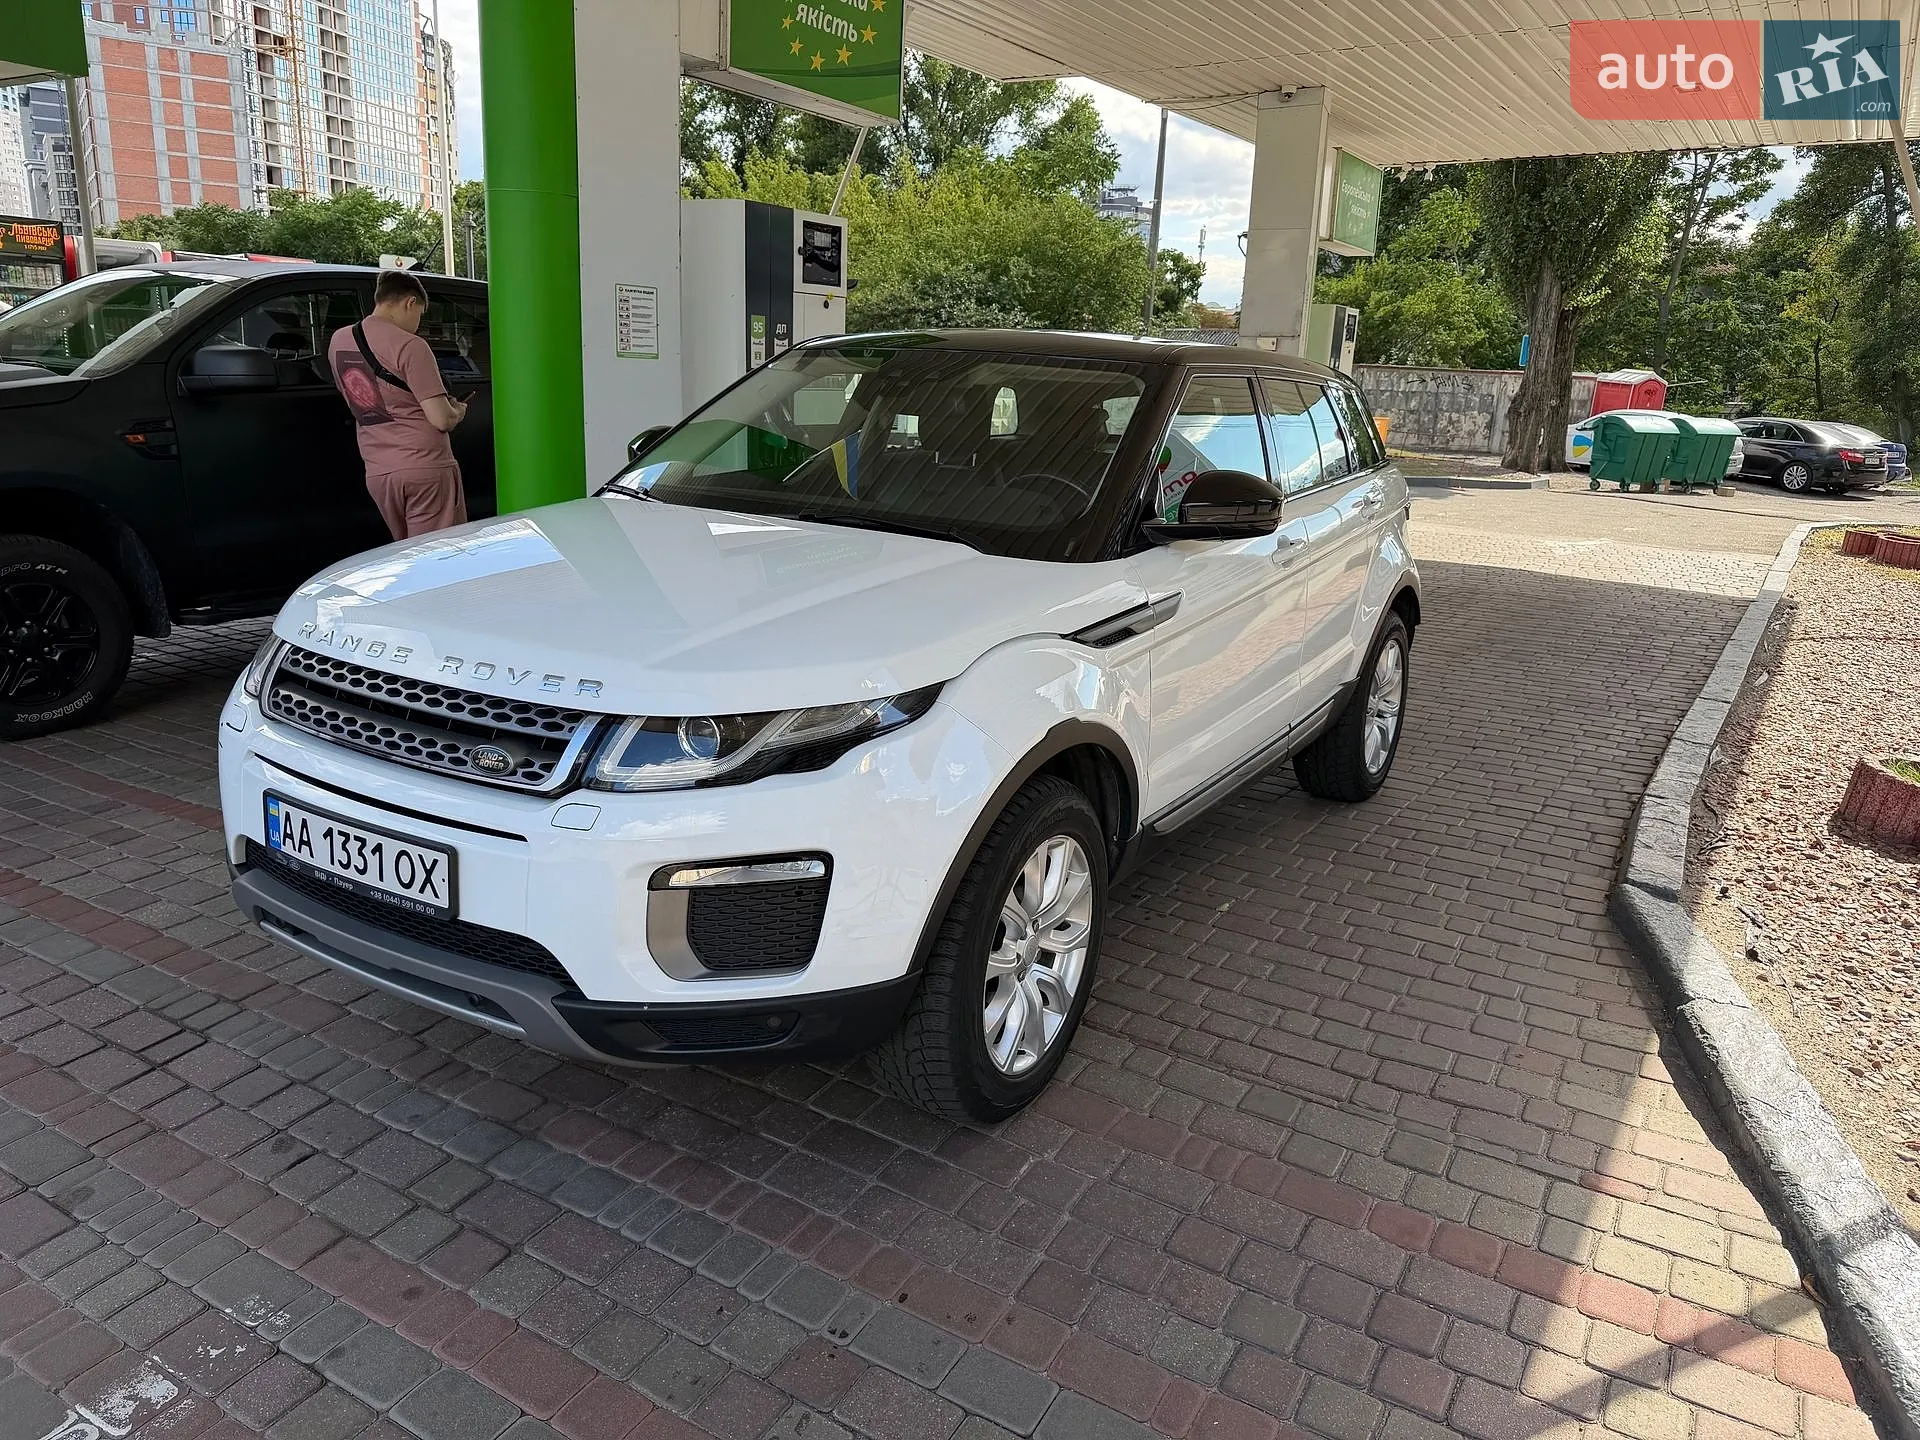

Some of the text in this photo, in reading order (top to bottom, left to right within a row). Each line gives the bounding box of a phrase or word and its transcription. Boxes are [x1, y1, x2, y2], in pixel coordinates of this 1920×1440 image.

[796, 3, 858, 43] якість
[8, 223, 60, 240] ЛЬВІВСЬКА
[753, 322, 764, 333] 95
[297, 621, 605, 699] RANGE ROVER
[270, 829, 281, 843] UA
[282, 810, 441, 899] AA 1331 OX
[370, 890, 435, 916] +38 (044) 591 00 00
